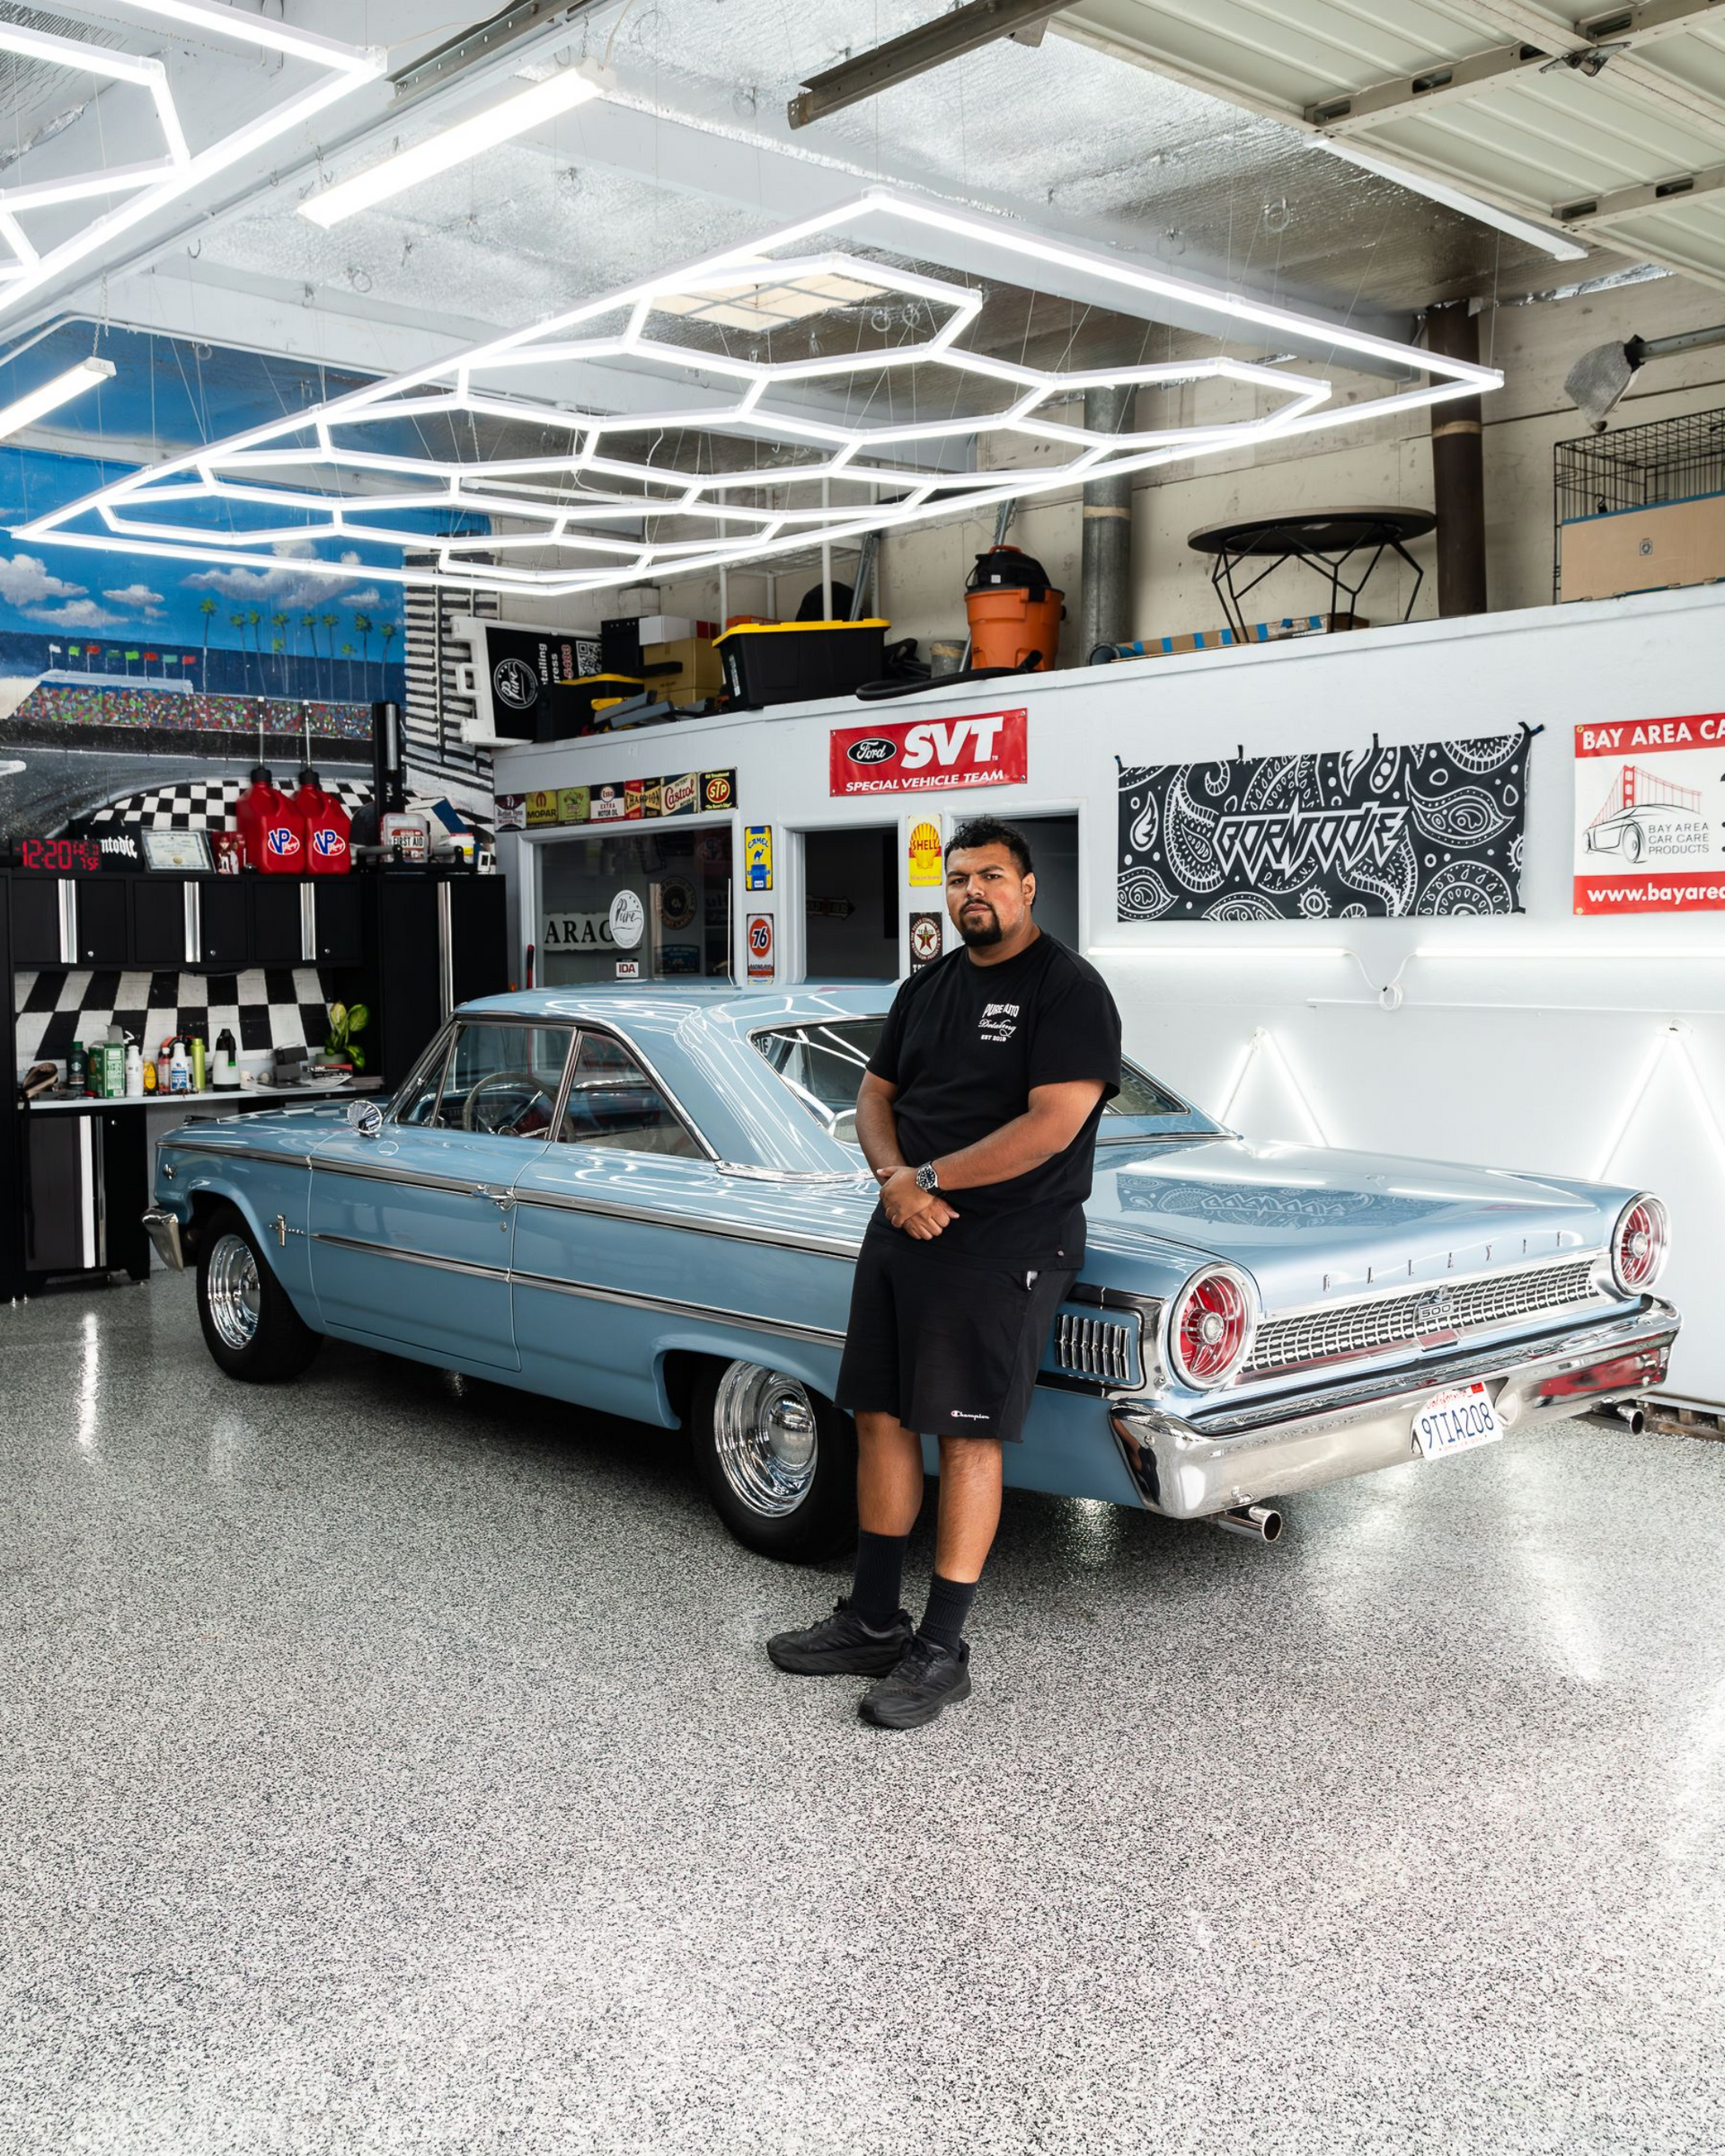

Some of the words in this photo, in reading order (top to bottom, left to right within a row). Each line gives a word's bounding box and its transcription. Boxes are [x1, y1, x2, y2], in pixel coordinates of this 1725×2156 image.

[562, 644, 574, 680] 5483
[900, 716, 1004, 769] SVT
[1582, 728, 1624, 750] BAY
[1631, 721, 1694, 747] AREA
[856, 741, 886, 760] Ford
[845, 778, 899, 791] SPECIAL
[901, 774, 960, 789] VEHICLE
[963, 769, 1004, 783] TEAM
[602, 790, 614, 798] Esso
[665, 778, 695, 810] Castrol
[710, 781, 727, 799] STP
[626, 790, 660, 810] CHAMPION
[526, 808, 557, 819] MOPAR
[597, 809, 611, 817] MOTOR
[1648, 824, 1672, 834] BAY
[1675, 822, 1710, 832] AREA
[269, 828, 291, 855] VP
[314, 829, 337, 855] VP
[393, 836, 412, 847] FIRST
[413, 836, 423, 846] AID
[748, 837, 769, 849] CAMEL
[913, 839, 938, 851] SHELL
[1648, 835, 1673, 844] CAR
[1676, 833, 1710, 844] CARE
[1648, 844, 1710, 855] PRODUCTS
[615, 898, 636, 925] Pure
[752, 926, 768, 950] 76
[618, 964, 636, 974] IDA
[982, 1003, 1004, 1018] PURE
[1003, 1003, 1020, 1018] AUTO
[978, 1019, 1017, 1038] Detailing
[1421, 1304, 1451, 1319] 500
[951, 1410, 990, 1420] Champion
[1421, 1402, 1494, 1449] 9TIA208
